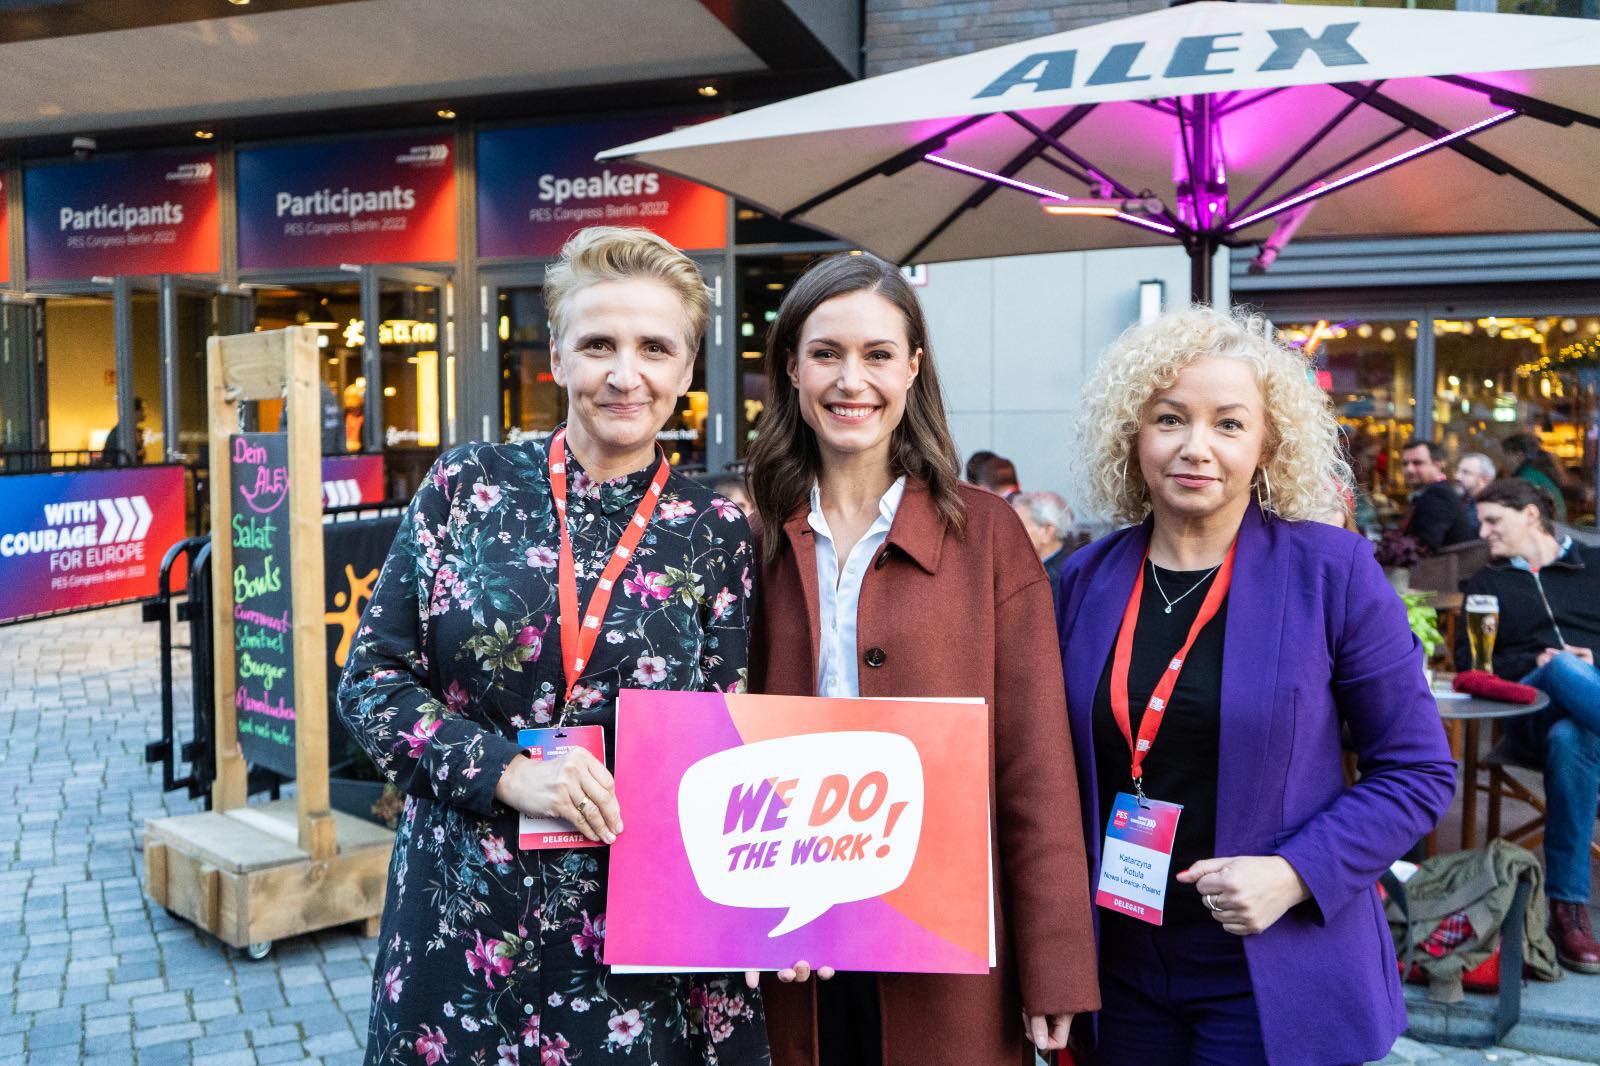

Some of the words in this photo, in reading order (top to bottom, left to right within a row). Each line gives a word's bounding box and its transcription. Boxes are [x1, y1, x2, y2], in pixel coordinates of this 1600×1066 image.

[972, 22, 1369, 99] ALEX
[538, 169, 659, 203] Speakers
[60, 200, 184, 231] Participants
[276, 185, 416, 217] Participants
[529, 208, 551, 222] PES
[553, 206, 604, 221] Congress
[607, 204, 637, 217] Berlin
[639, 201, 669, 216] 2022
[306, 220, 350, 236] Congress
[352, 219, 380, 233] Berlin
[233, 437, 267, 465] Dein
[44, 500, 97, 526] WITH
[0, 524, 97, 557] COURAGE
[232, 513, 277, 551] Salat
[50, 552, 82, 573] FOR
[86, 542, 144, 567] EUROPE
[234, 555, 281, 603] Bowls
[239, 652, 287, 691] Burger
[723, 776, 800, 836] WE
[808, 770, 889, 828] DO
[543, 834, 584, 844] DELEGATE
[727, 840, 781, 873] THE
[1120, 853, 1152, 870] Katarzyna
[1104, 871, 1120, 882] Nowa
[1142, 883, 1162, 896] Poland
[1113, 899, 1146, 915] DELEGATE
